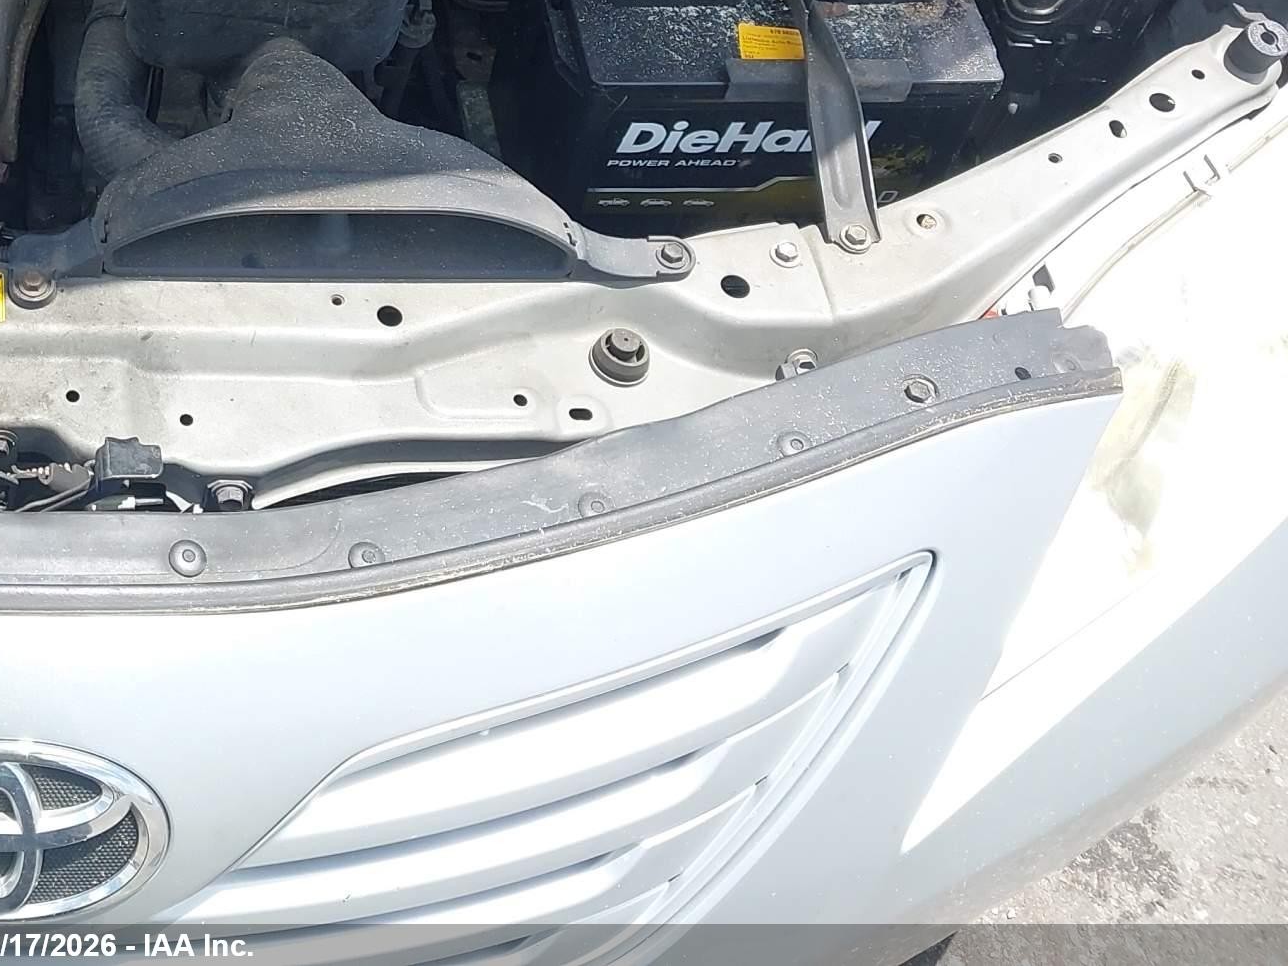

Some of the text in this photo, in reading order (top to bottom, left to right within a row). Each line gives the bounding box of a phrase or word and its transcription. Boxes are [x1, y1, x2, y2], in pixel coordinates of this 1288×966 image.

[616, 120, 883, 154] DieHa
[607, 159, 737, 168] POWER AHEAD
